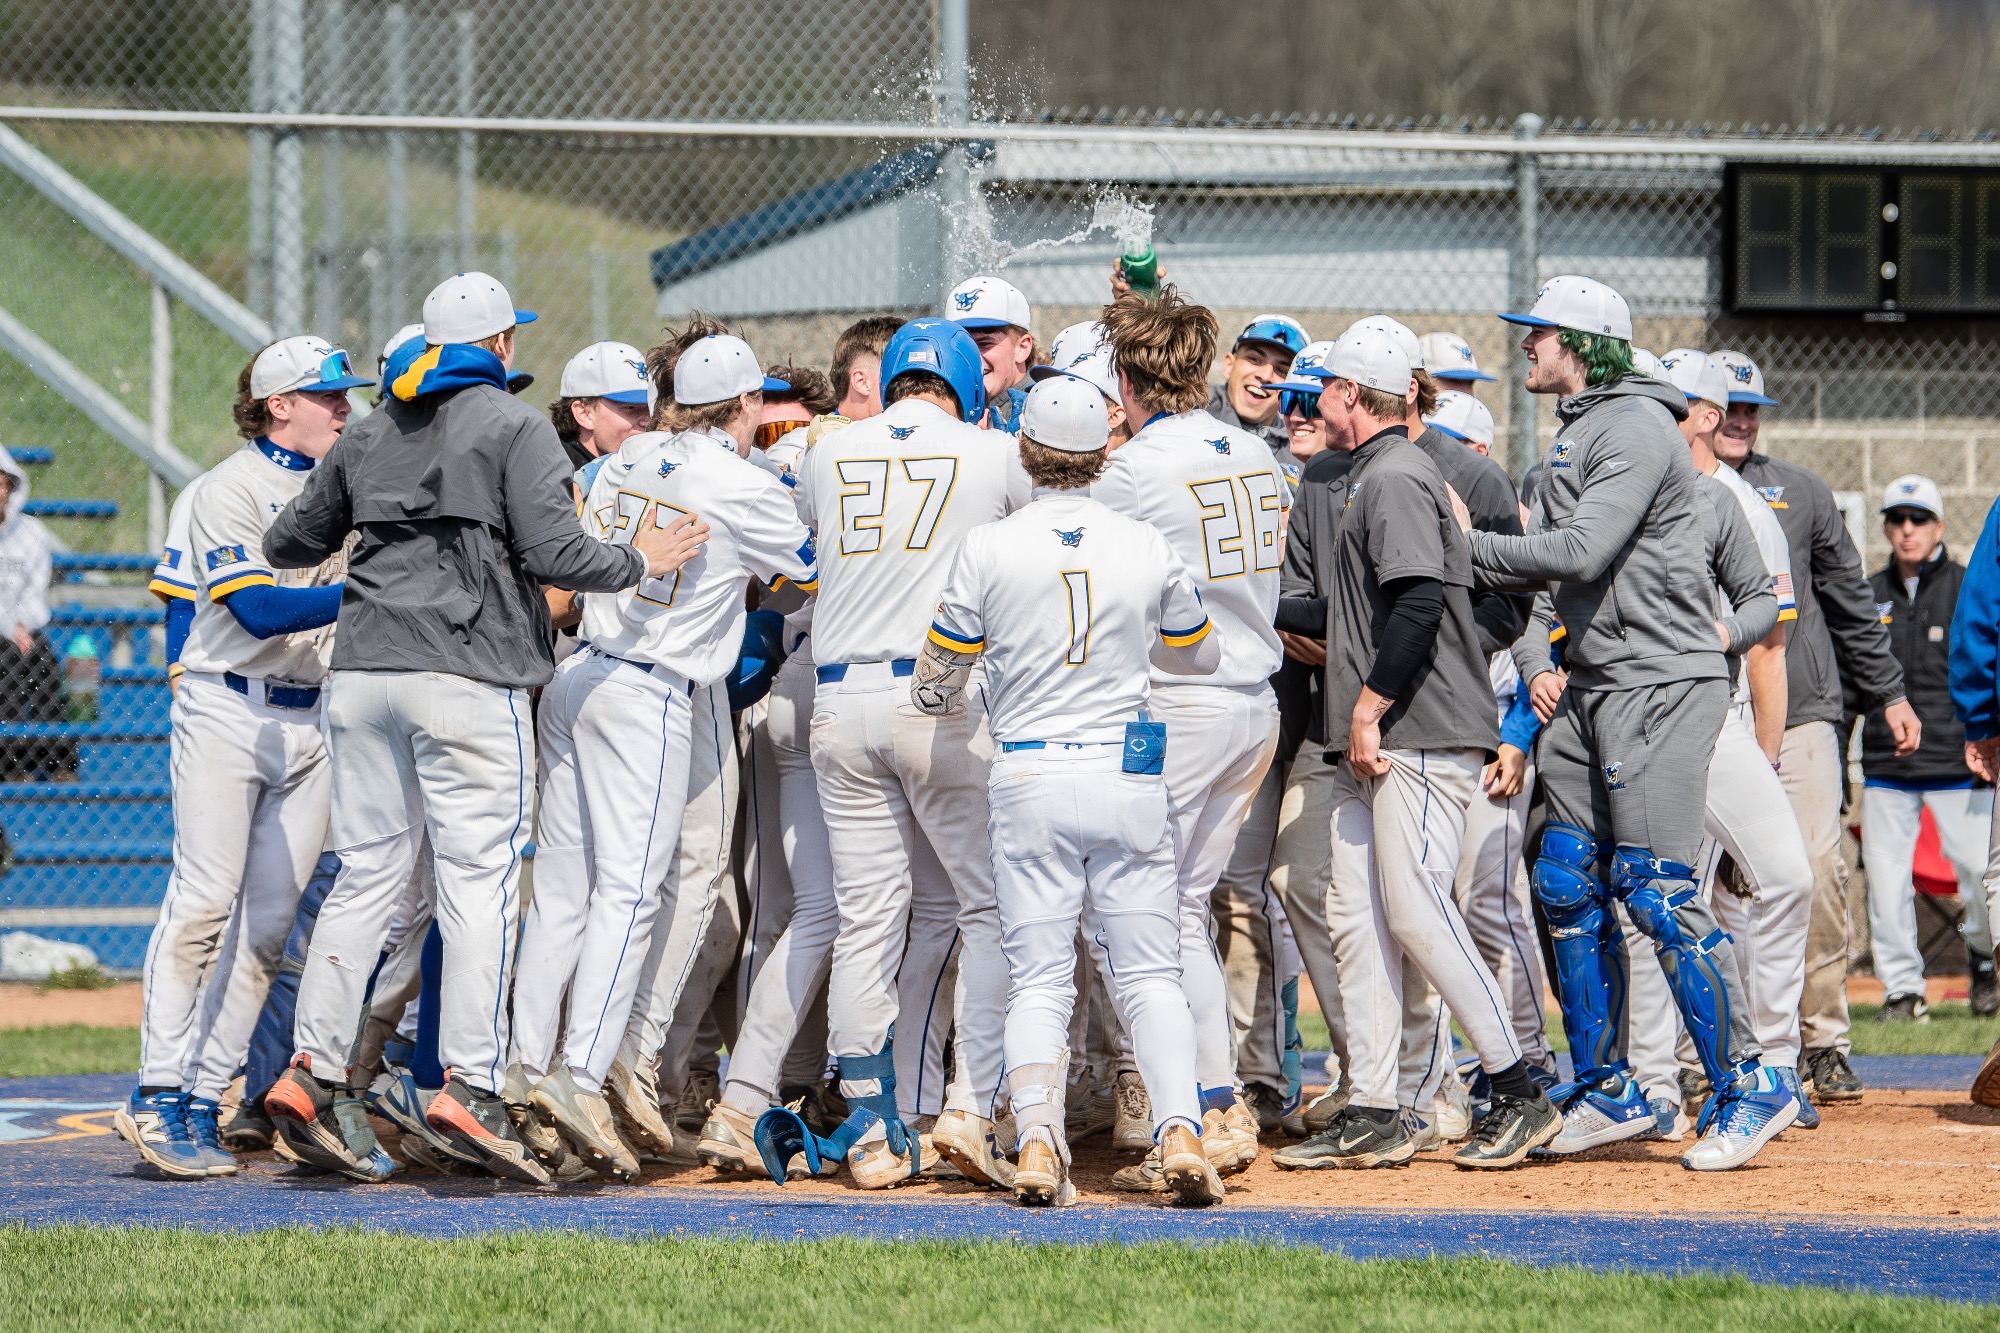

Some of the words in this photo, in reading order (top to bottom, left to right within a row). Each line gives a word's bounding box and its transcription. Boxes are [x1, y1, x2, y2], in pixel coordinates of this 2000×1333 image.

[835, 456, 960, 558] 27
[1186, 471, 1280, 581] 26
[1061, 569, 1091, 667] 1
